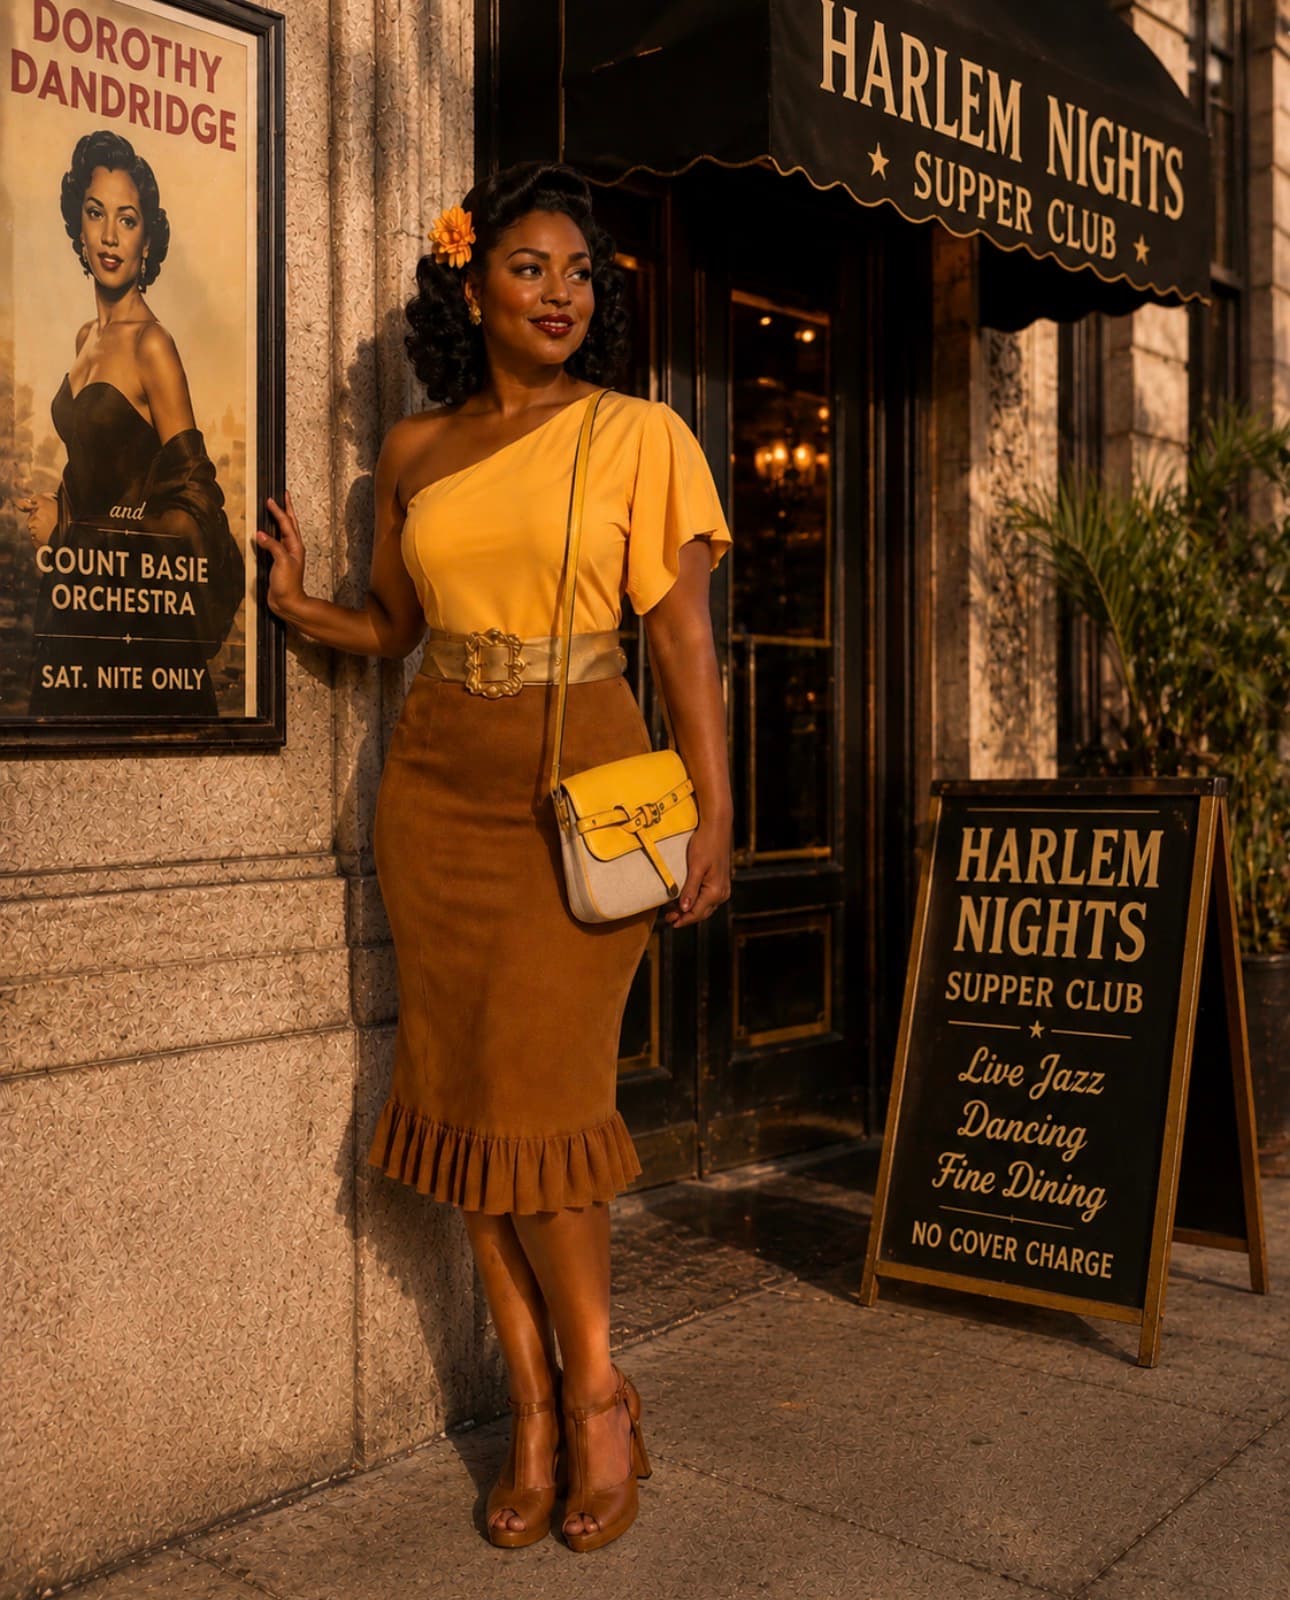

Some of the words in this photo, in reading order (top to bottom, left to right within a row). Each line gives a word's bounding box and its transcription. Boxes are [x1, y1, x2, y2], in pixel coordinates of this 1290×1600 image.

[33, 0, 222, 93] DOROTHY
[11, 48, 237, 152] DANDRIDGE
[819, 0, 1022, 163] HARLEM
[1046, 95, 1184, 221] NIGHTS
[913, 150, 1033, 234] SUPPER
[1047, 198, 1117, 260] CLUB
[110, 502, 147, 521] and
[36, 545, 129, 577] COUNT
[141, 553, 209, 584] BASIE
[51, 584, 196, 616] ORCHESTRA
[41, 665, 88, 689] SAT.
[97, 666, 142, 689] NITE
[151, 668, 206, 690] ONLY
[956, 827, 1164, 889] HARLEM
[953, 895, 1147, 963] NIGHTS
[944, 970, 1052, 1008] SUPPER
[1065, 978, 1144, 1015] CLUB
[958, 1045, 1023, 1087] Live
[1028, 1053, 1105, 1100] Jazz
[957, 1099, 1087, 1162] Dancing
[931, 1151, 995, 1195] Fine
[1002, 1160, 1107, 1223] Dining
[912, 1220, 942, 1248] NO
[949, 1226, 1017, 1262] COVER
[1024, 1240, 1114, 1279] CHARGE
